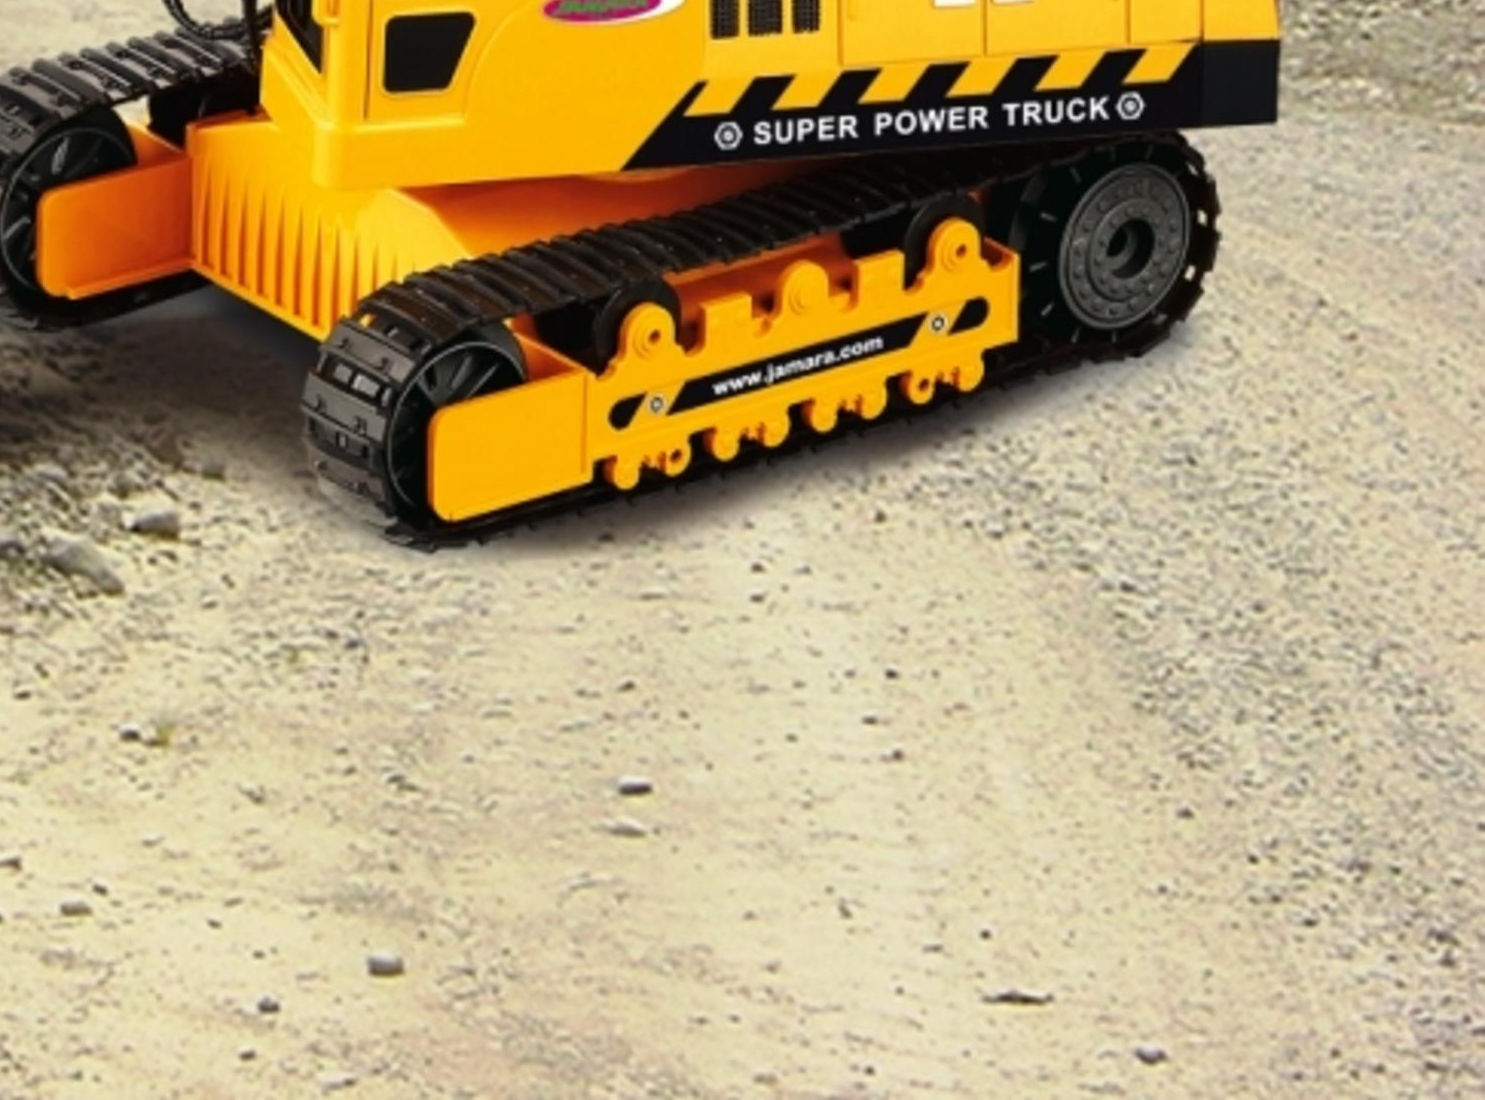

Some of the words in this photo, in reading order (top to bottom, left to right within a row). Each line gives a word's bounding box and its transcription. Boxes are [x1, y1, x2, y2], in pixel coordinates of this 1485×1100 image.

[753, 114, 859, 145] SUPER
[874, 105, 989, 136] POWER
[1002, 96, 1110, 127] TRUCK
[712, 336, 884, 395] www.jamara.com
